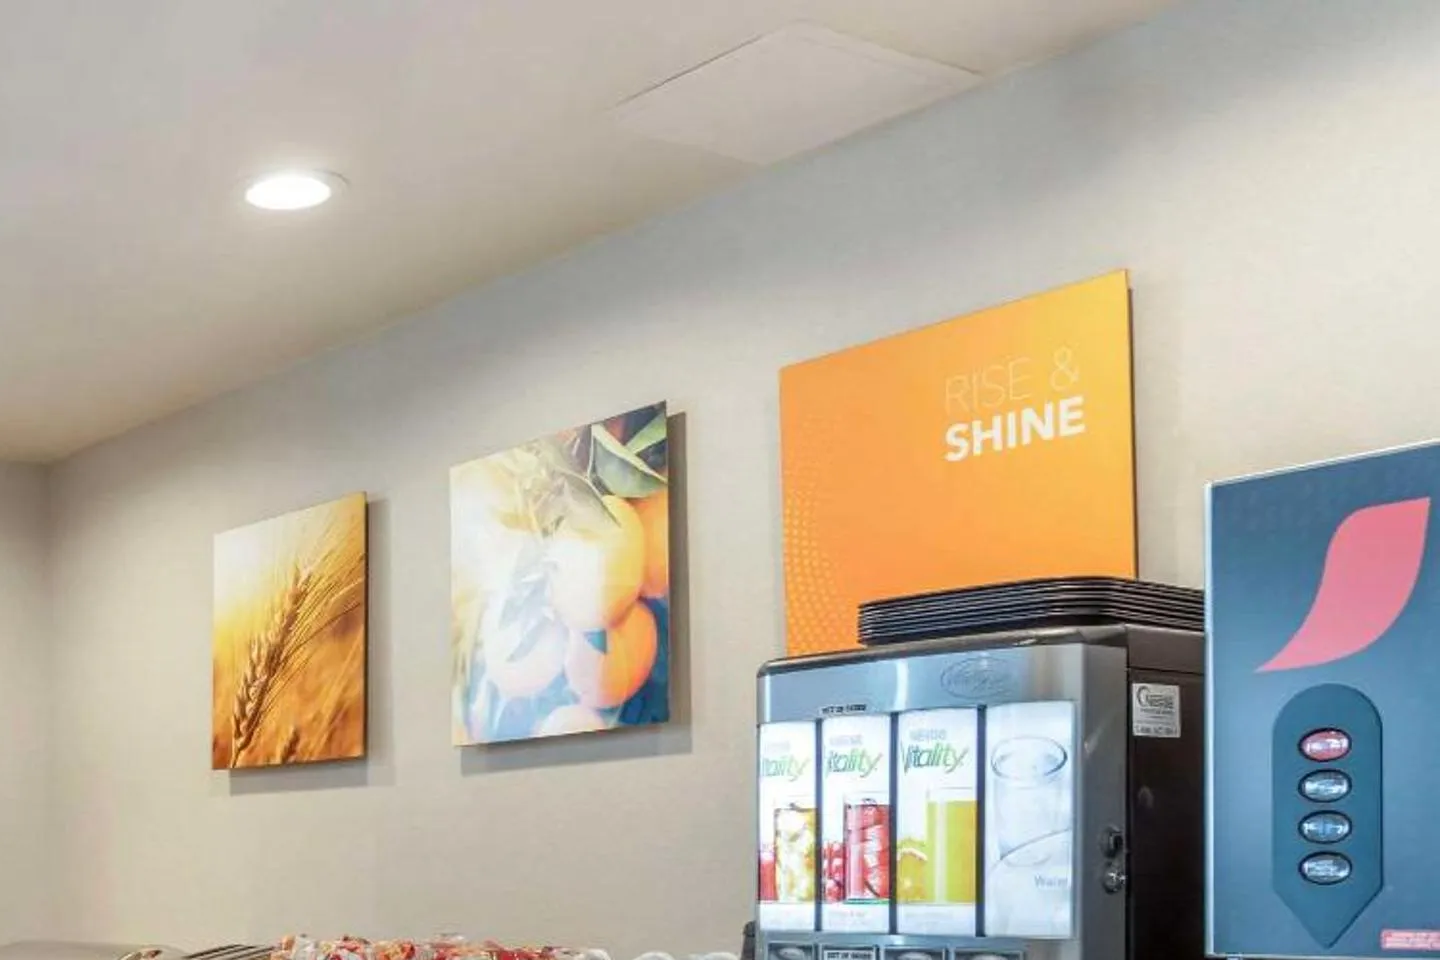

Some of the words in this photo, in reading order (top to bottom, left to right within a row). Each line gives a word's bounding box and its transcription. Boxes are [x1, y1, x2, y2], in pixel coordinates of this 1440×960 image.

[945, 356, 1033, 416] RISE
[1050, 346, 1080, 392] &
[944, 395, 1086, 462] SHINE
